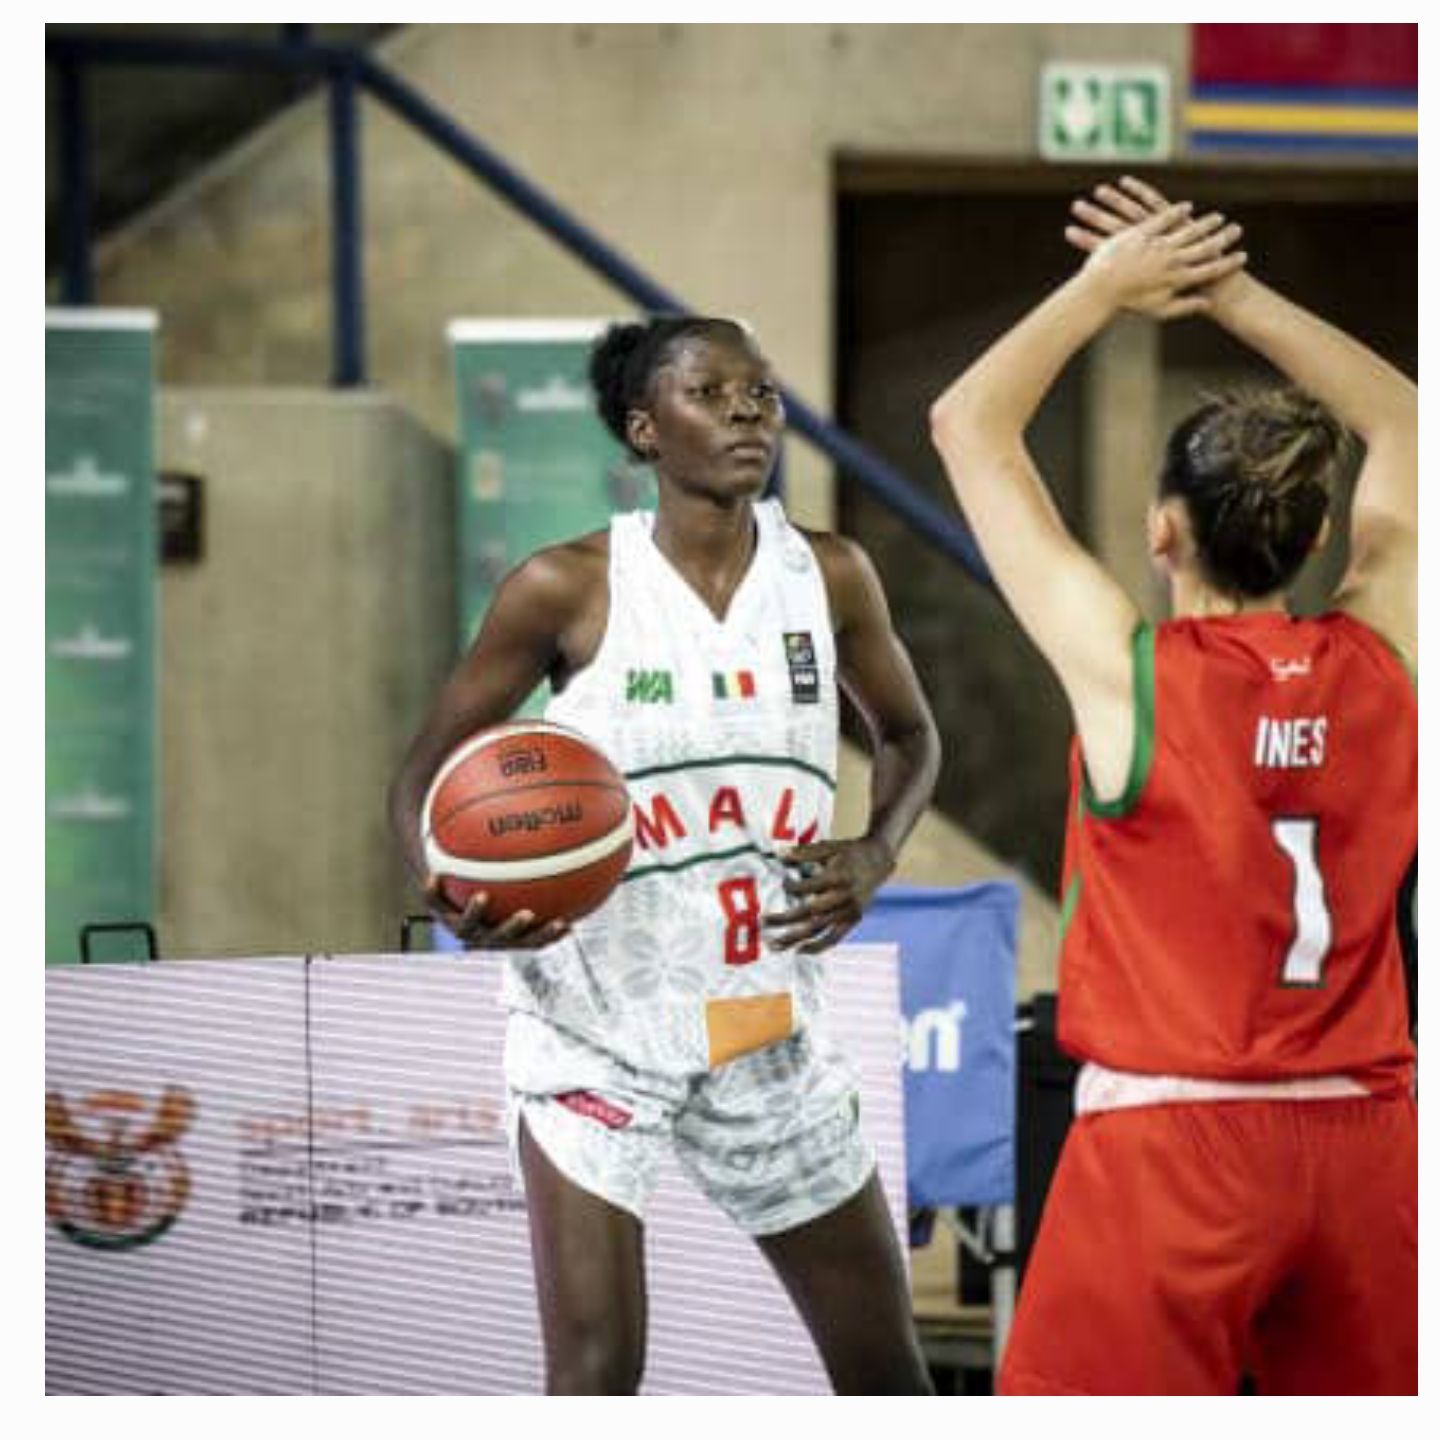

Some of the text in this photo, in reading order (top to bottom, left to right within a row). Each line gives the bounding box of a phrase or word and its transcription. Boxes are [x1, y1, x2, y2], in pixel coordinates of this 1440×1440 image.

[626, 669, 674, 705] WA
[1254, 714, 1328, 769] INES
[717, 875, 760, 965] 8
[1270, 816, 1334, 987] 1
